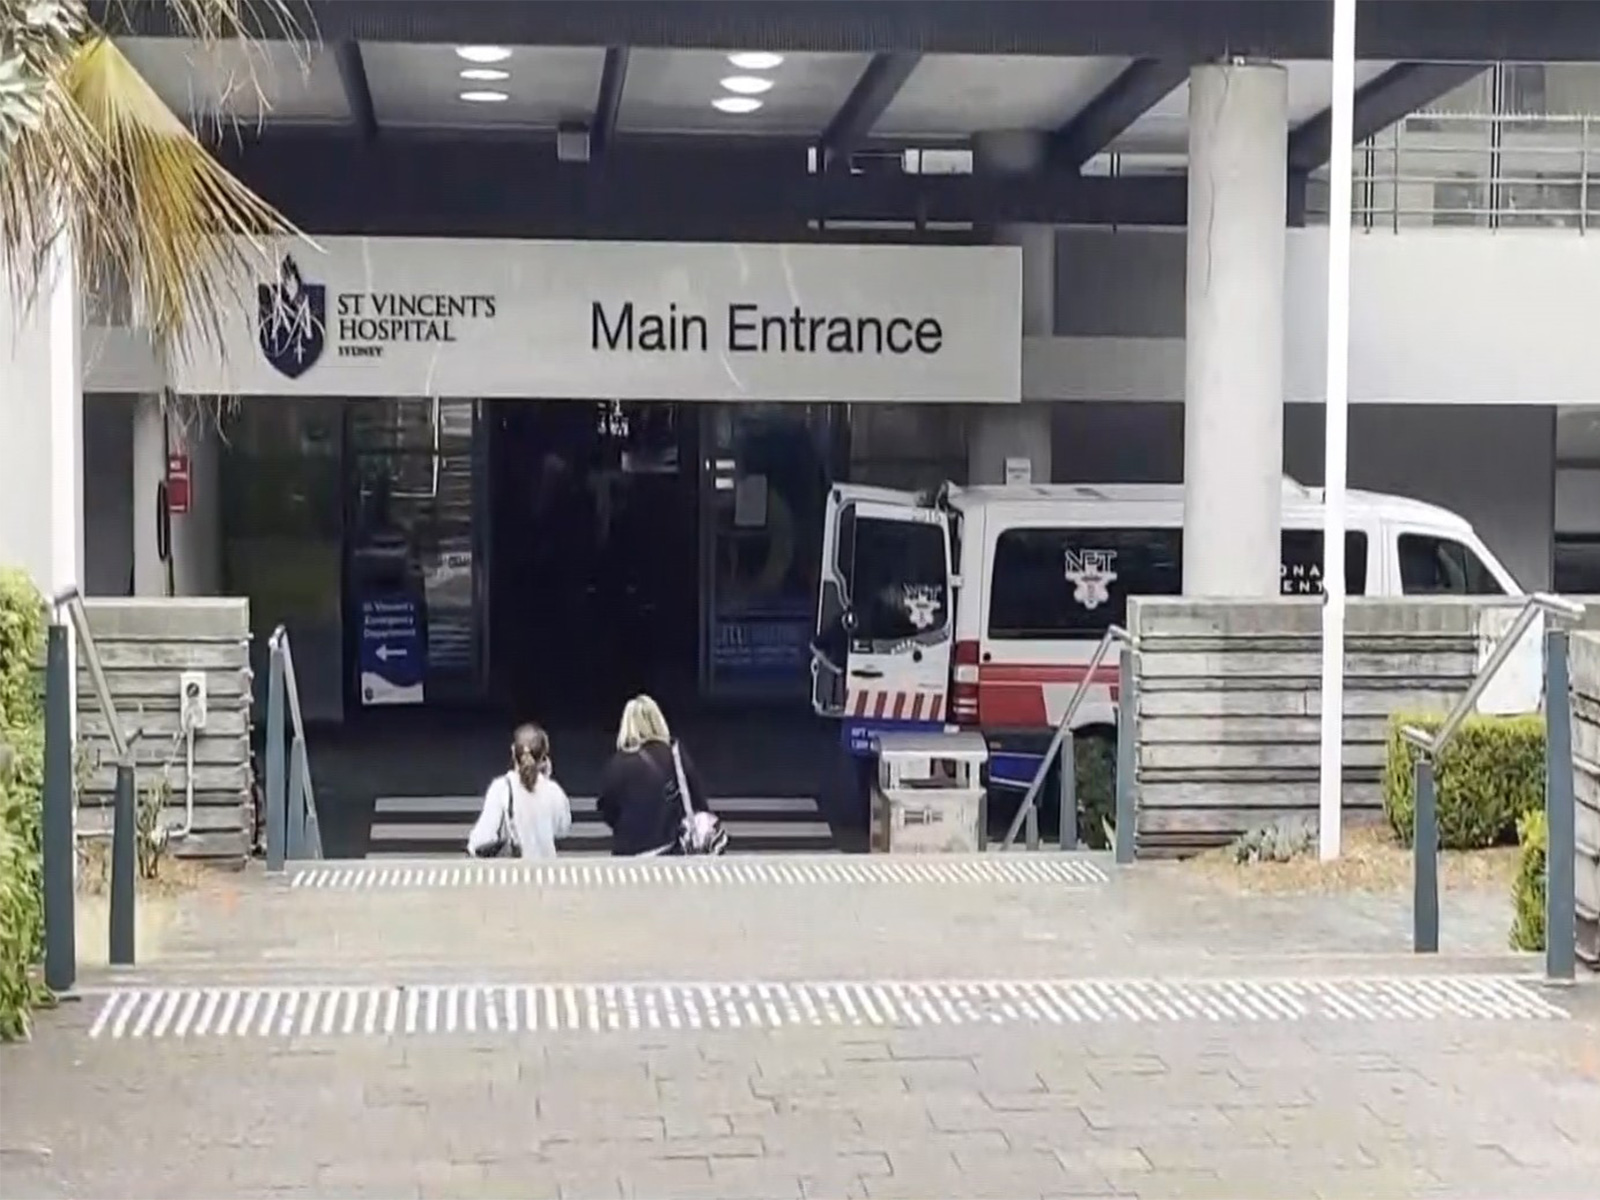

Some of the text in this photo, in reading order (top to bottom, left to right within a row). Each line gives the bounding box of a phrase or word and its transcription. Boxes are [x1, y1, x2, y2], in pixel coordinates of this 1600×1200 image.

[338, 293, 365, 316] ST
[339, 318, 457, 341] HOSPITAL
[592, 301, 943, 354] Main Entrance
[1065, 549, 1117, 573] NPT
